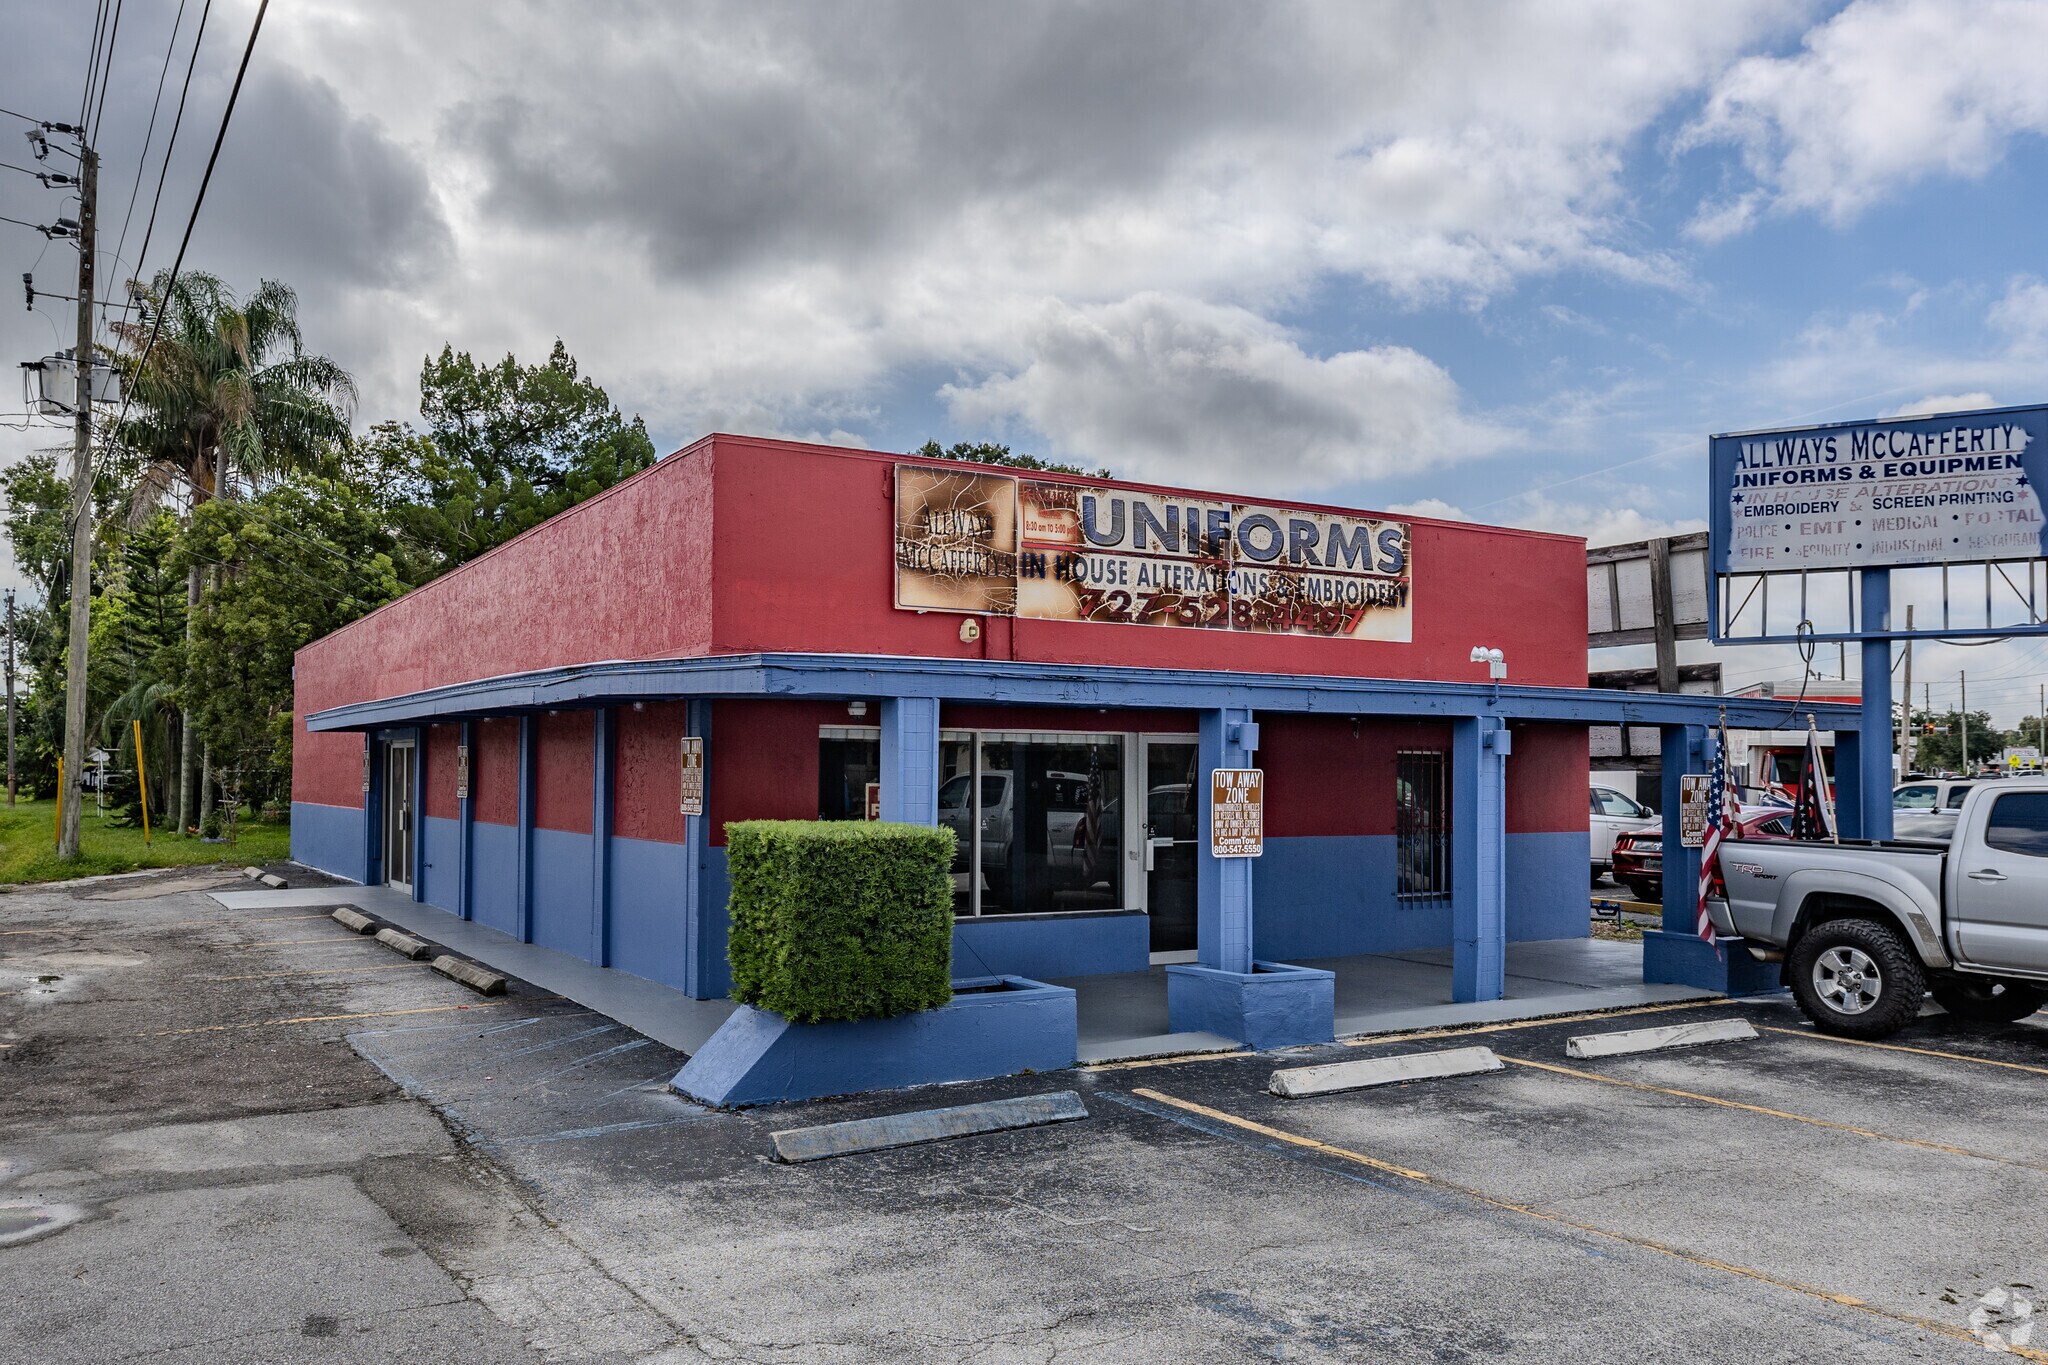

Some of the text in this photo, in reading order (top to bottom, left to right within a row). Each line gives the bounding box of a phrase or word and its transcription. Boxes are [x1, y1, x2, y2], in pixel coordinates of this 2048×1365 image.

[1737, 424, 2023, 469] ALLWAYS MCCAFFERTY'
[1859, 465, 1876, 480] &
[1884, 454, 2023, 477] EQUIPMEN
[1744, 490, 2014, 517] EMBROIDERY & SCREEN PRINTING
[1747, 493, 1768, 504] IN
[1082, 495, 1404, 574] UNIFORMS
[1022, 552, 1408, 608] IN HOUSE ALTERATIONS & EMBROIDERY
[1079, 588, 1364, 633] 727-528-4497
[1215, 772, 1260, 788] TOW AWAY
[1683, 777, 1711, 790] TOW AWA
[1226, 788, 1249, 803] ZONE
[1690, 790, 1706, 803] ZONE
[1219, 836, 1256, 845] CommTow
[1214, 845, 1261, 854] 800-547-5550
[1732, 863, 1764, 874] TRD
